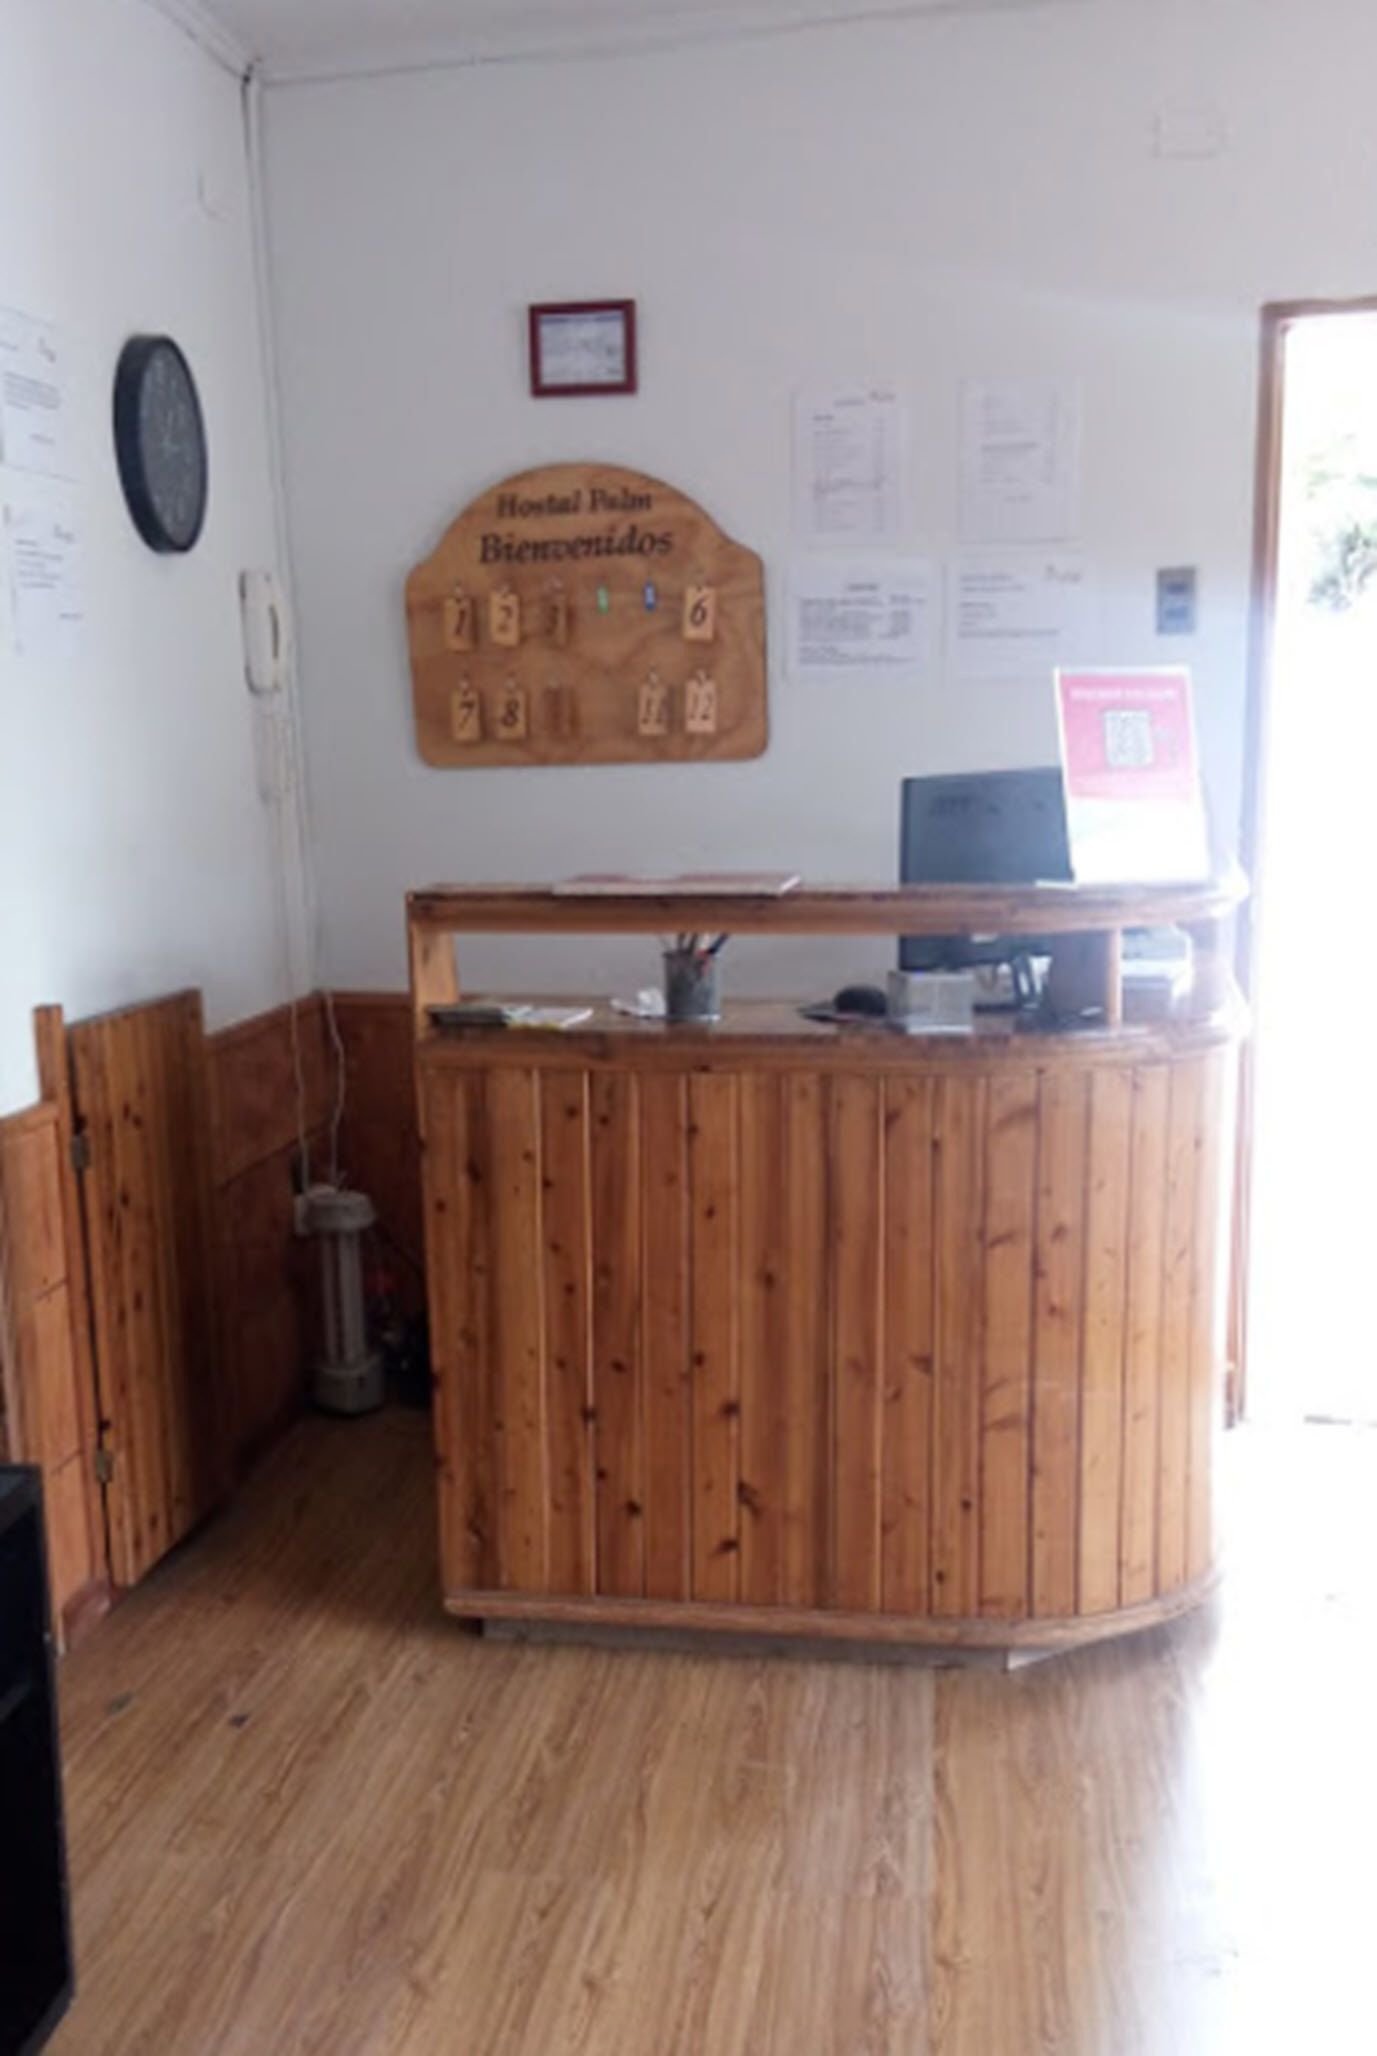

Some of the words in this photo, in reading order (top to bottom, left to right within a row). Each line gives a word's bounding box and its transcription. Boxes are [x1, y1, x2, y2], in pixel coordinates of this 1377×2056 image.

[498, 490, 581, 518] Hostal
[591, 488, 652, 513] Palm
[481, 526, 674, 564] Bienvenidos
[497, 607, 514, 633] 2
[689, 597, 708, 626] 6
[458, 701, 475, 727] 7
[501, 701, 520, 727] 8
[688, 696, 714, 723] 12
